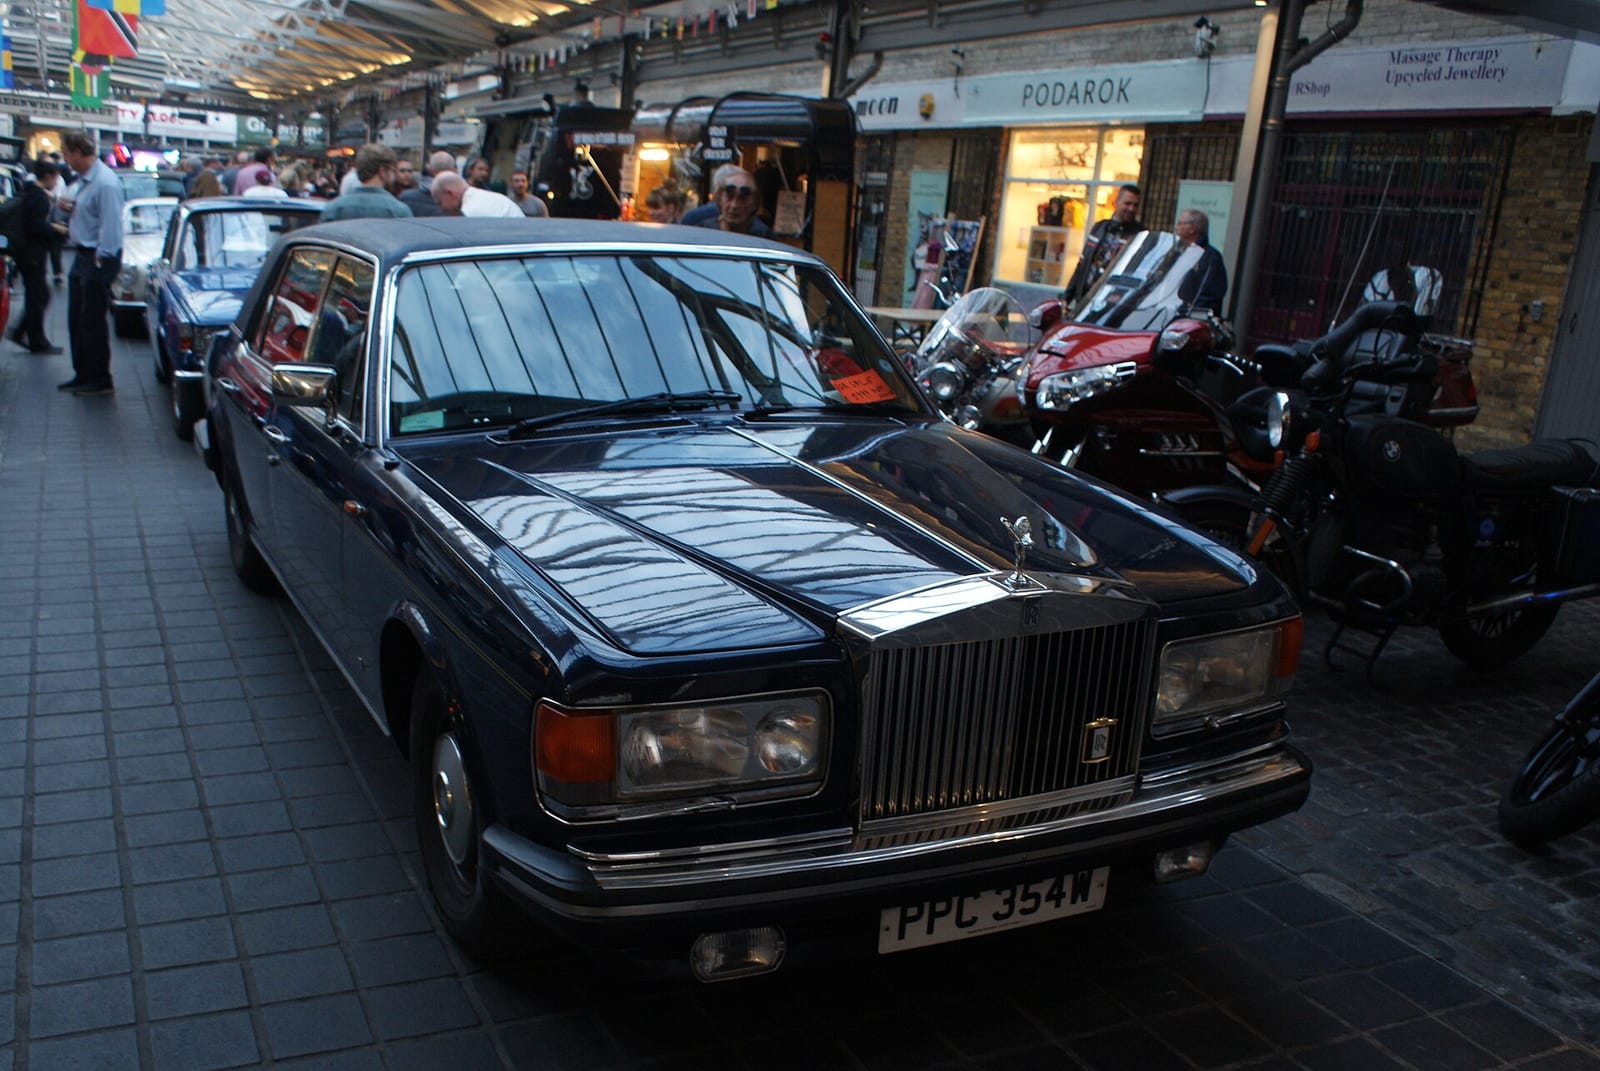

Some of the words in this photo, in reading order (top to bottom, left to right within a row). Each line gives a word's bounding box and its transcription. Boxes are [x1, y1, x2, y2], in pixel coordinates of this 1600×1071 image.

[1388, 50, 1441, 66] Massage
[1446, 47, 1502, 64] Therapy
[1385, 67, 1442, 87] Upcycled
[1444, 64, 1509, 82] Jewellery
[1022, 77, 1132, 108] PODAROK
[897, 897, 978, 941] PPC
[992, 868, 1094, 922] 354W
